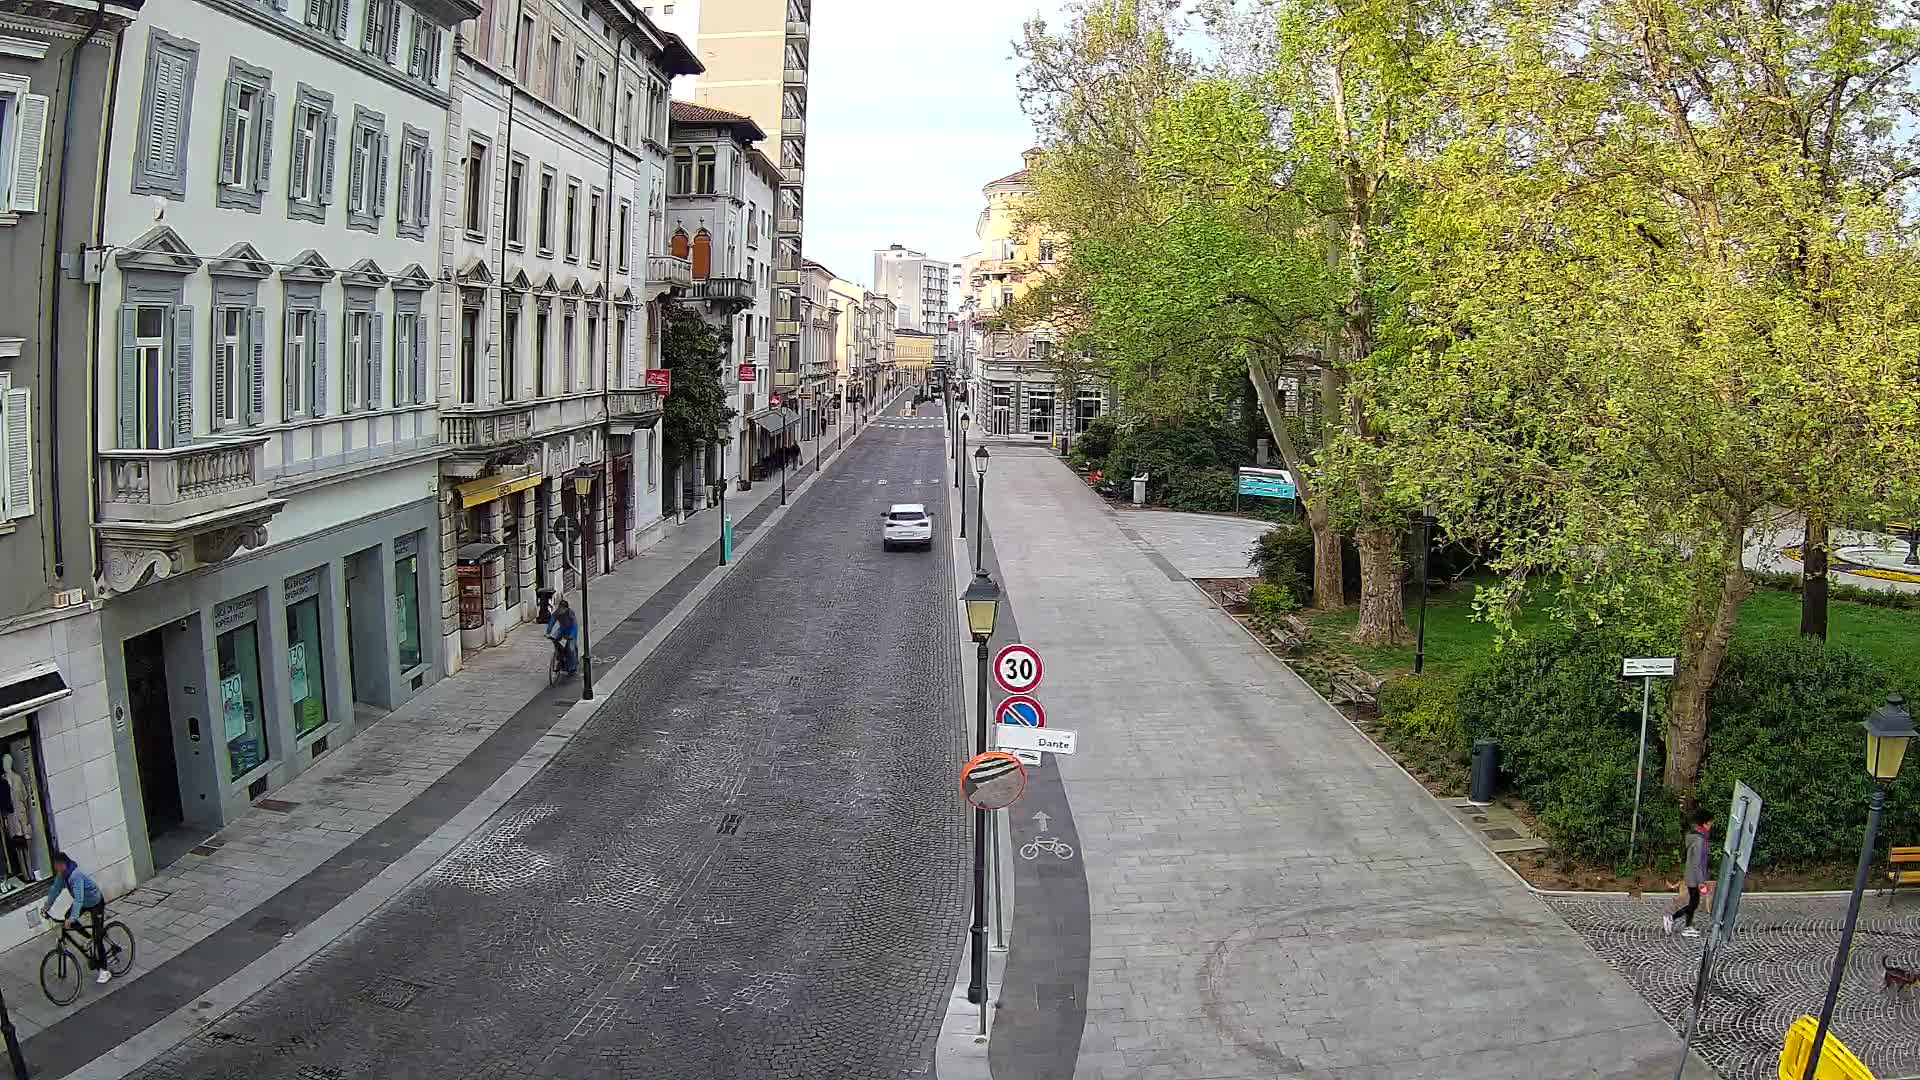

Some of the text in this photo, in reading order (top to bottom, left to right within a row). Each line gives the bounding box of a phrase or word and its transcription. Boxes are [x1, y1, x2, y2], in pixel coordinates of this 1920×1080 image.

[1005, 658, 1033, 680] 30
[222, 677, 241, 700] 130
[1038, 738, 1070, 749] Dante
